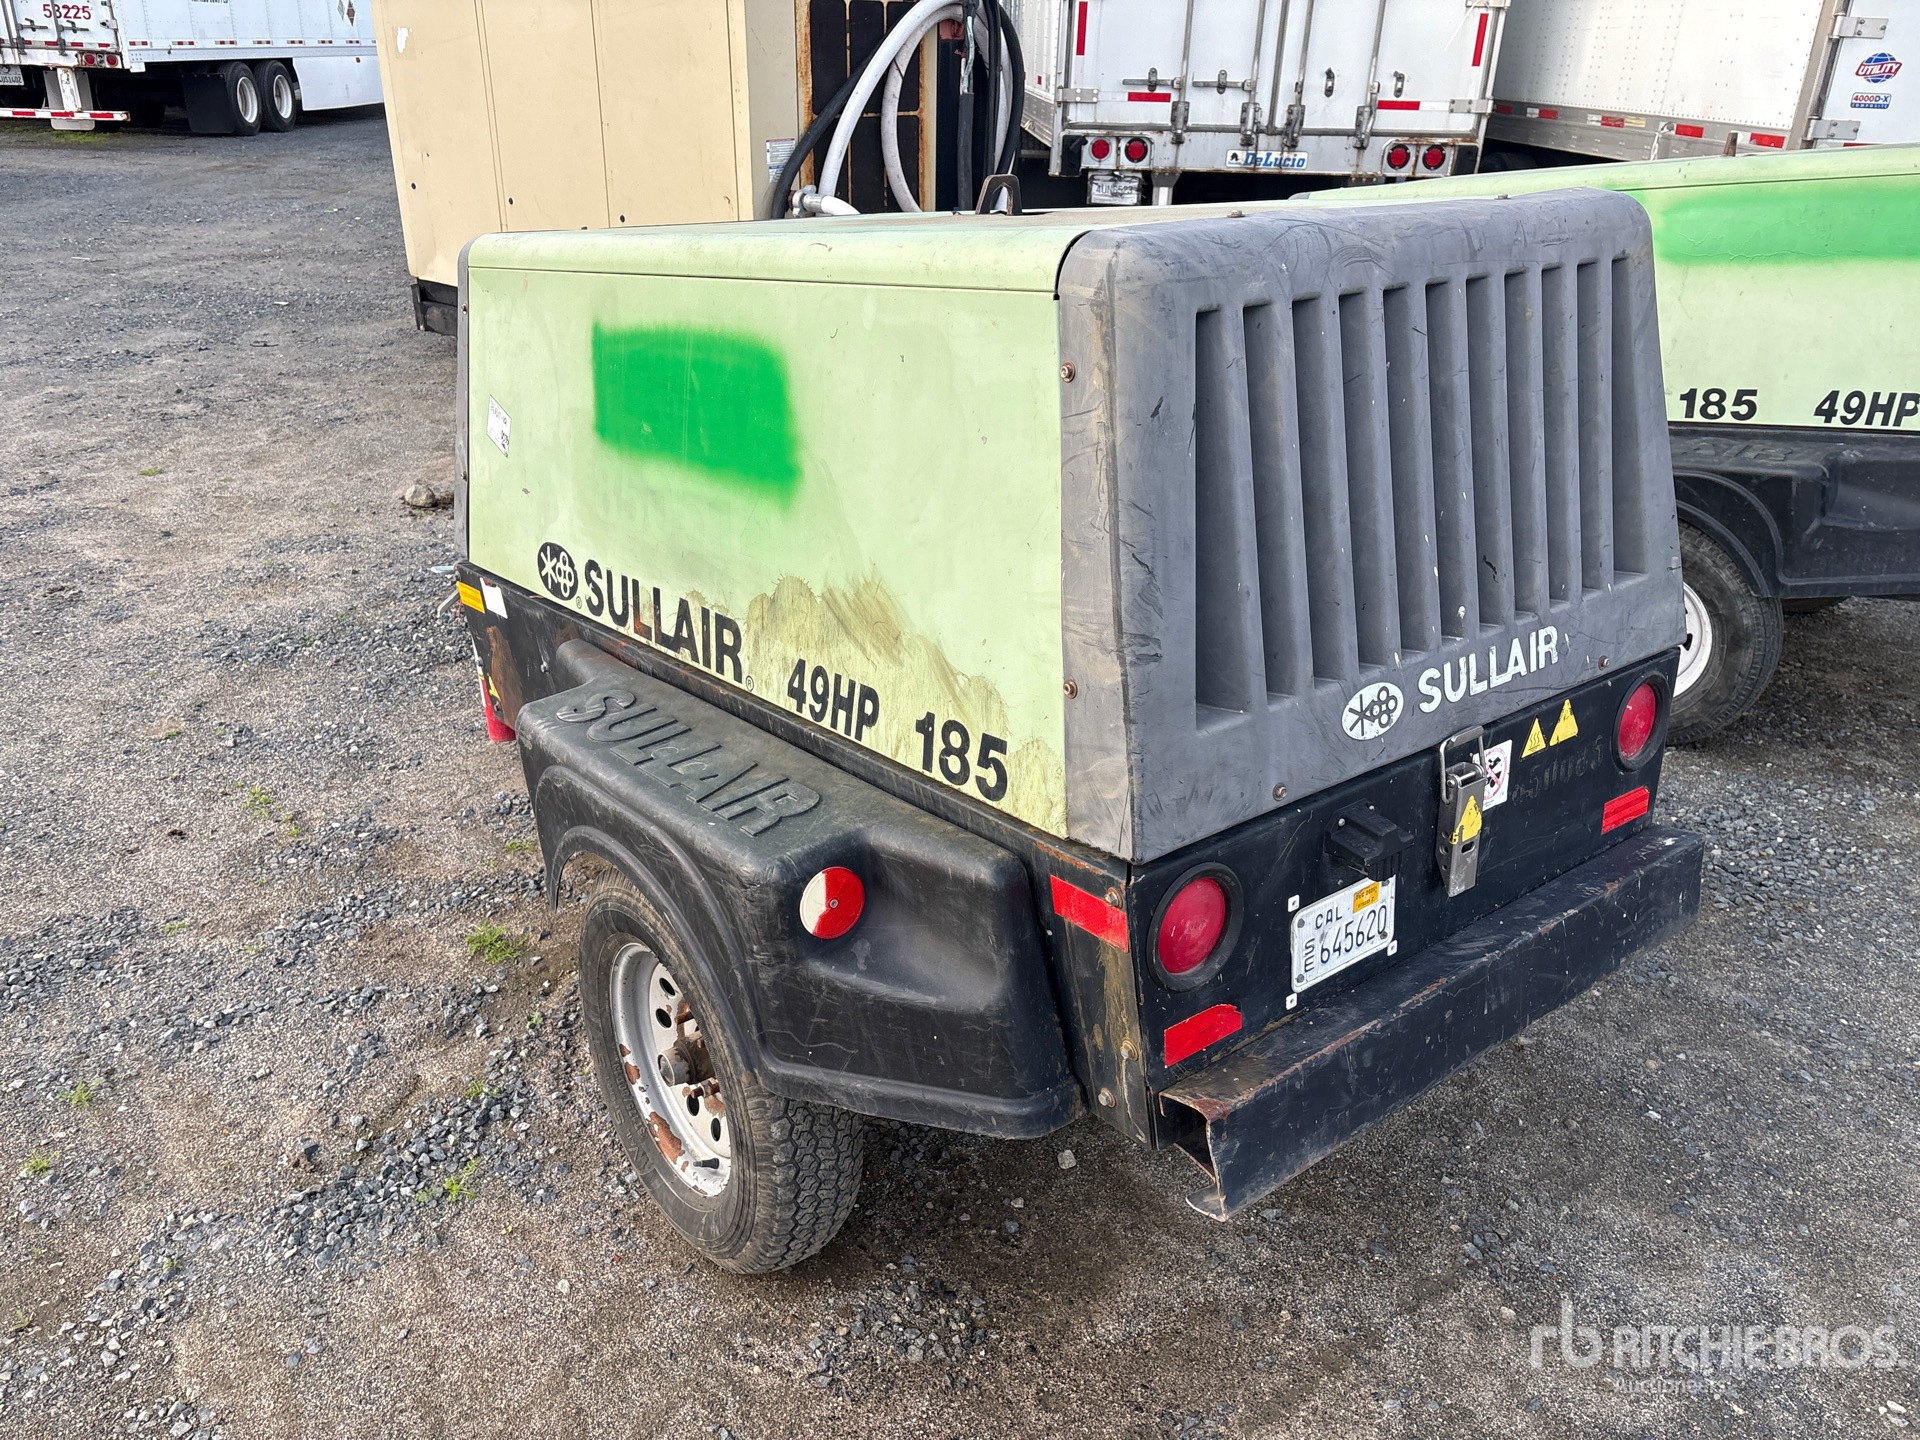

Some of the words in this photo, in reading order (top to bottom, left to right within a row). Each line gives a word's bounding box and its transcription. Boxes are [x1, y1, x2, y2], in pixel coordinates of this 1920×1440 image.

[1858, 63, 1900, 76] UTILITY
[1853, 95, 1890, 103] 4000D-X
[1243, 152, 1306, 168] DeLucio
[1679, 388, 1758, 421] 185
[1813, 390, 1920, 427] 49HP
[584, 559, 743, 685] SULLAIR
[1418, 625, 1559, 713] SULLAIR
[787, 658, 880, 743] 49HP
[915, 711, 1008, 802] 185
[556, 689, 821, 838] SULLAIR
[1315, 906, 1343, 930] CAL
[1320, 904, 1387, 964] 645620
[1304, 937, 1315, 973] SE
